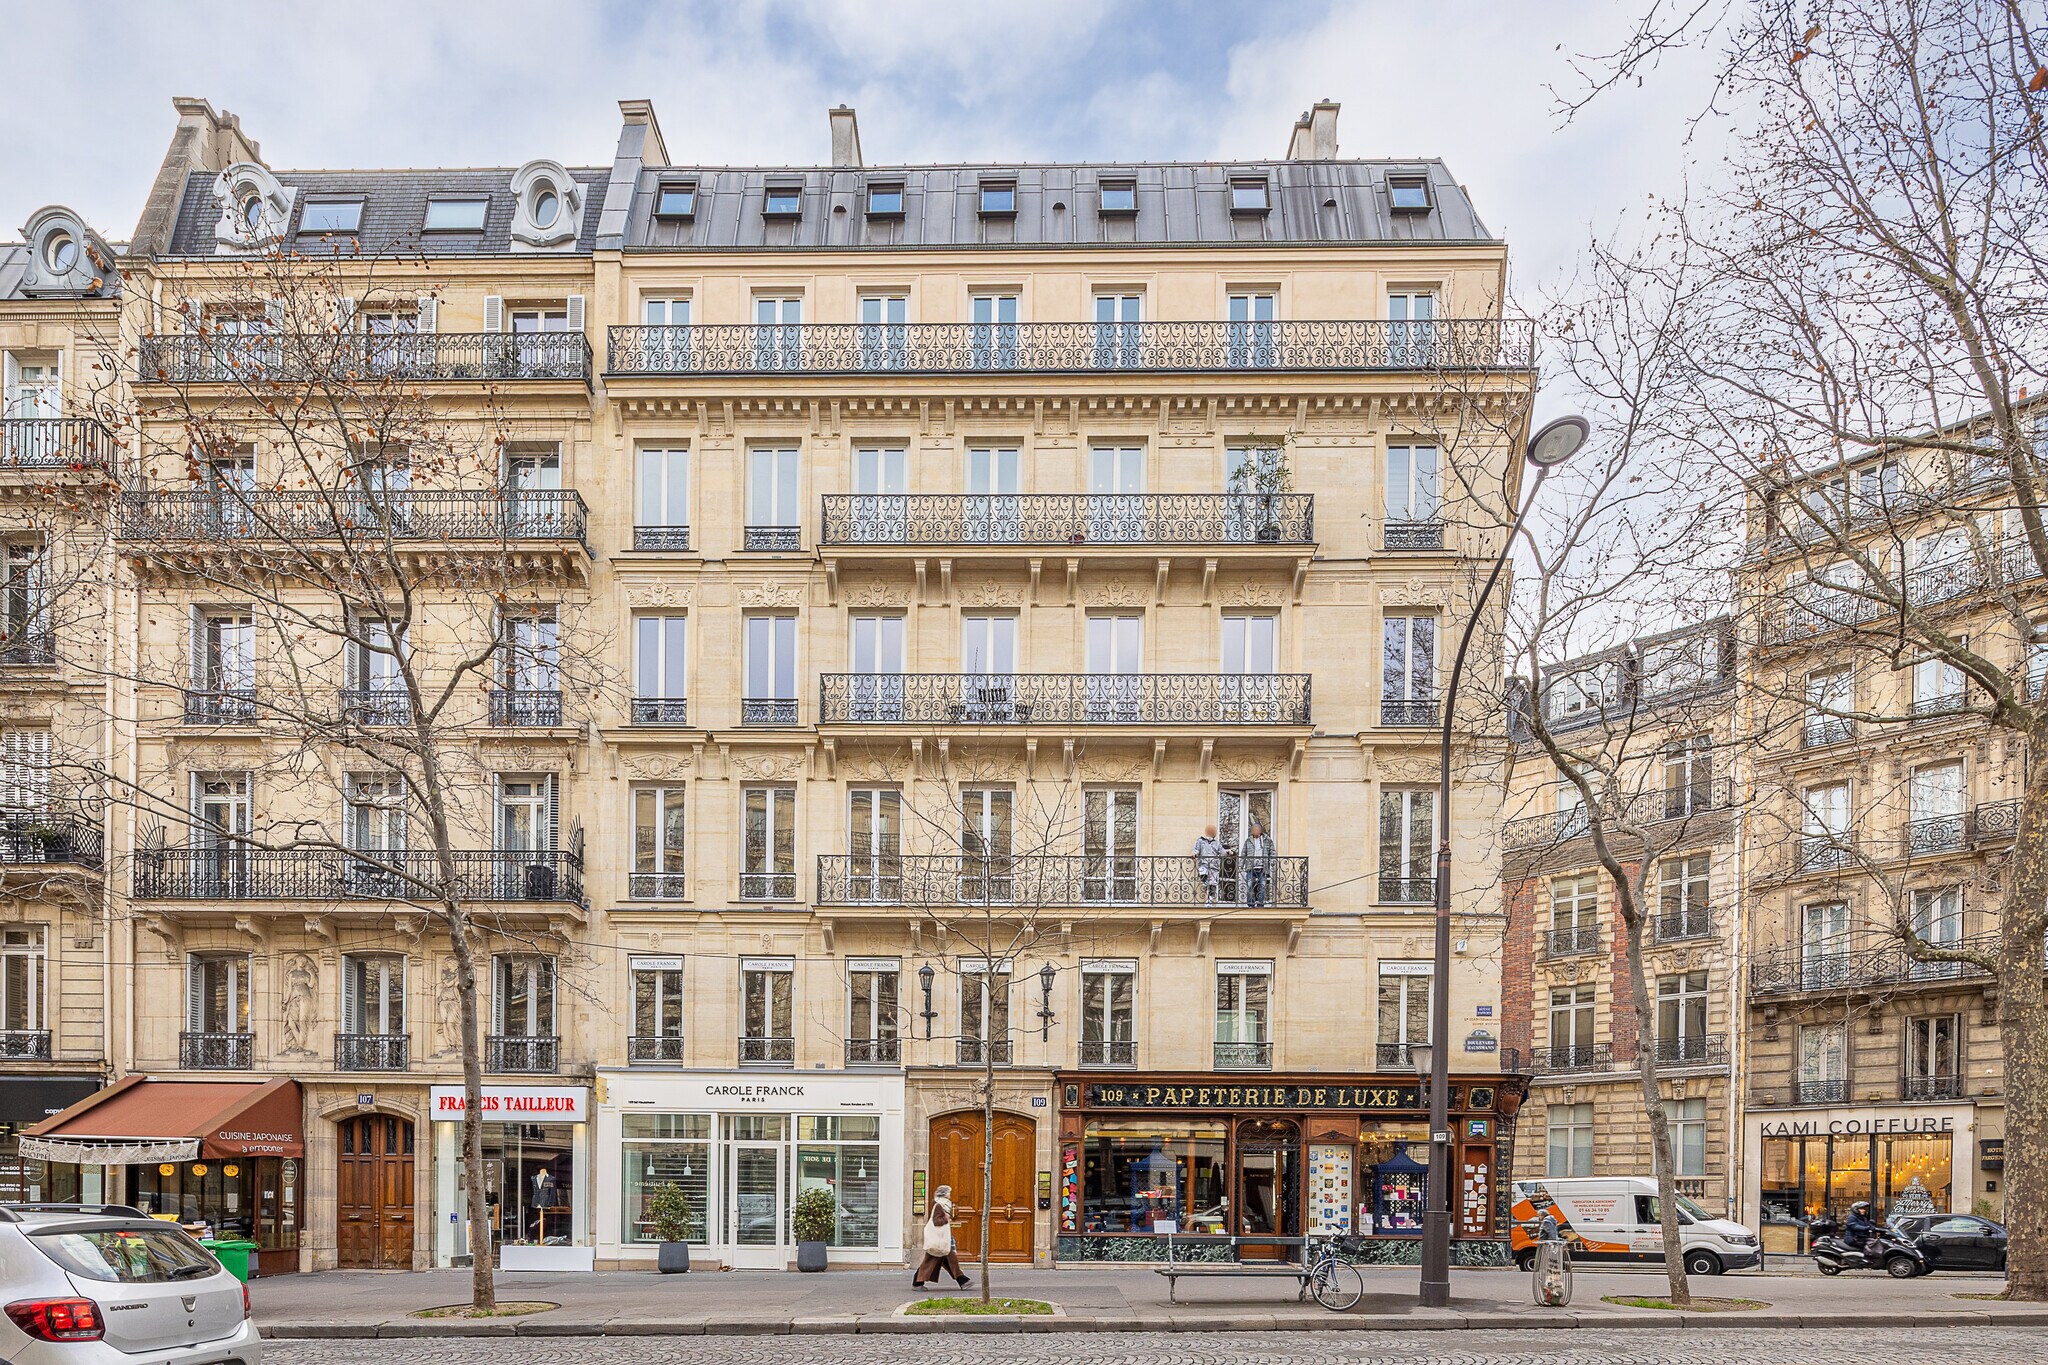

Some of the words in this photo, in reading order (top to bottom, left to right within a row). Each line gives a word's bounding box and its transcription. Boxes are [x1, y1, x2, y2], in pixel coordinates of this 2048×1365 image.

[705, 1086, 752, 1095] CAROLE
[756, 1086, 804, 1095] FRANCK
[359, 1095, 372, 1104] 107
[1101, 1090, 1123, 1102] 109
[1146, 1088, 1285, 1105] PAPETERIE
[1298, 1089, 1326, 1105] DE
[1338, 1089, 1399, 1106] LUXE
[439, 1097, 499, 1110] FRACIS
[504, 1097, 575, 1111] TAILLEUR
[1033, 1098, 1046, 1106] 109
[1761, 1121, 1817, 1136] KAMI
[1829, 1117, 1953, 1134] COIFFURE
[219, 1132, 250, 1140] CUISINE
[252, 1133, 292, 1142] JAPONAISE
[110, 1303, 148, 1311] SANDERO
